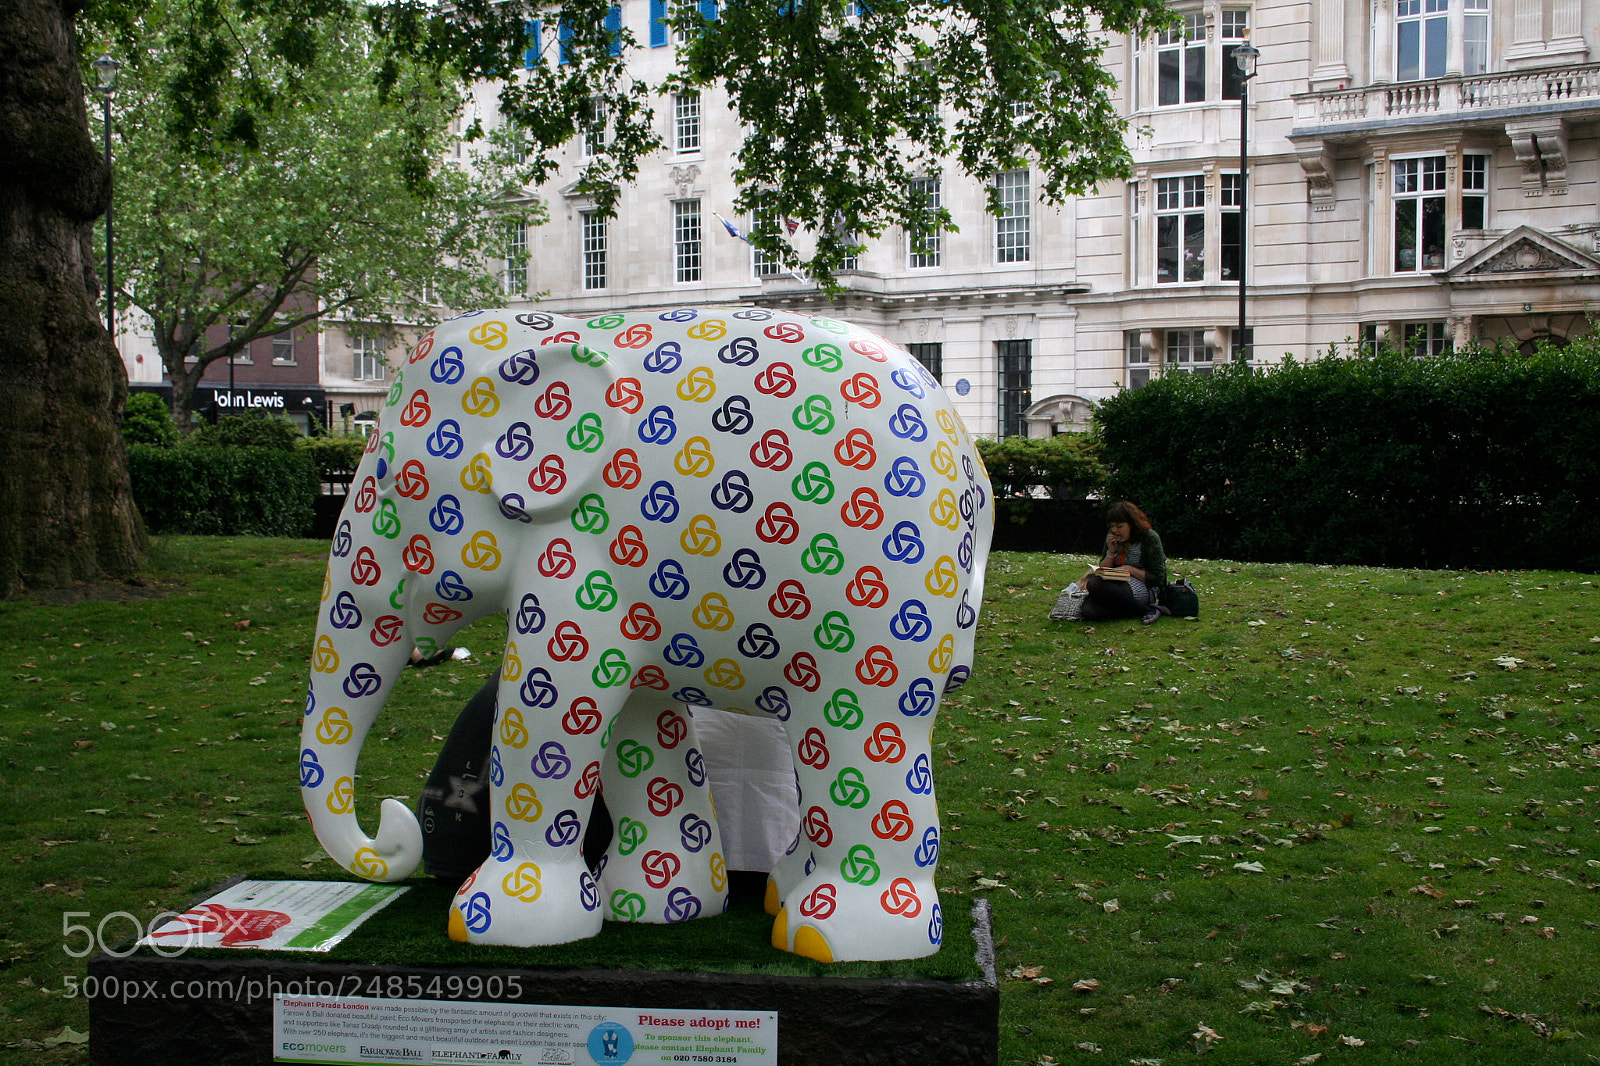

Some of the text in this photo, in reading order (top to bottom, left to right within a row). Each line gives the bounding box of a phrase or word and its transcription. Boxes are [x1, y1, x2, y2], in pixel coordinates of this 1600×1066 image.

[247, 390, 284, 408] Lewis
[283, 1000, 314, 1008] Elephant
[430, 1006, 438, 1014] by
[436, 1017, 470, 1025] transported
[638, 1015, 685, 1028] Please
[690, 1016, 730, 1030] adopt
[734, 1018, 761, 1028] me!
[658, 1034, 692, 1042] sponsor
[694, 1034, 711, 1042] this
[432, 1050, 482, 1058] ELEPHANT
[633, 1044, 659, 1052] please
[696, 1046, 734, 1054] Elephant
[736, 1046, 766, 1055] Family
